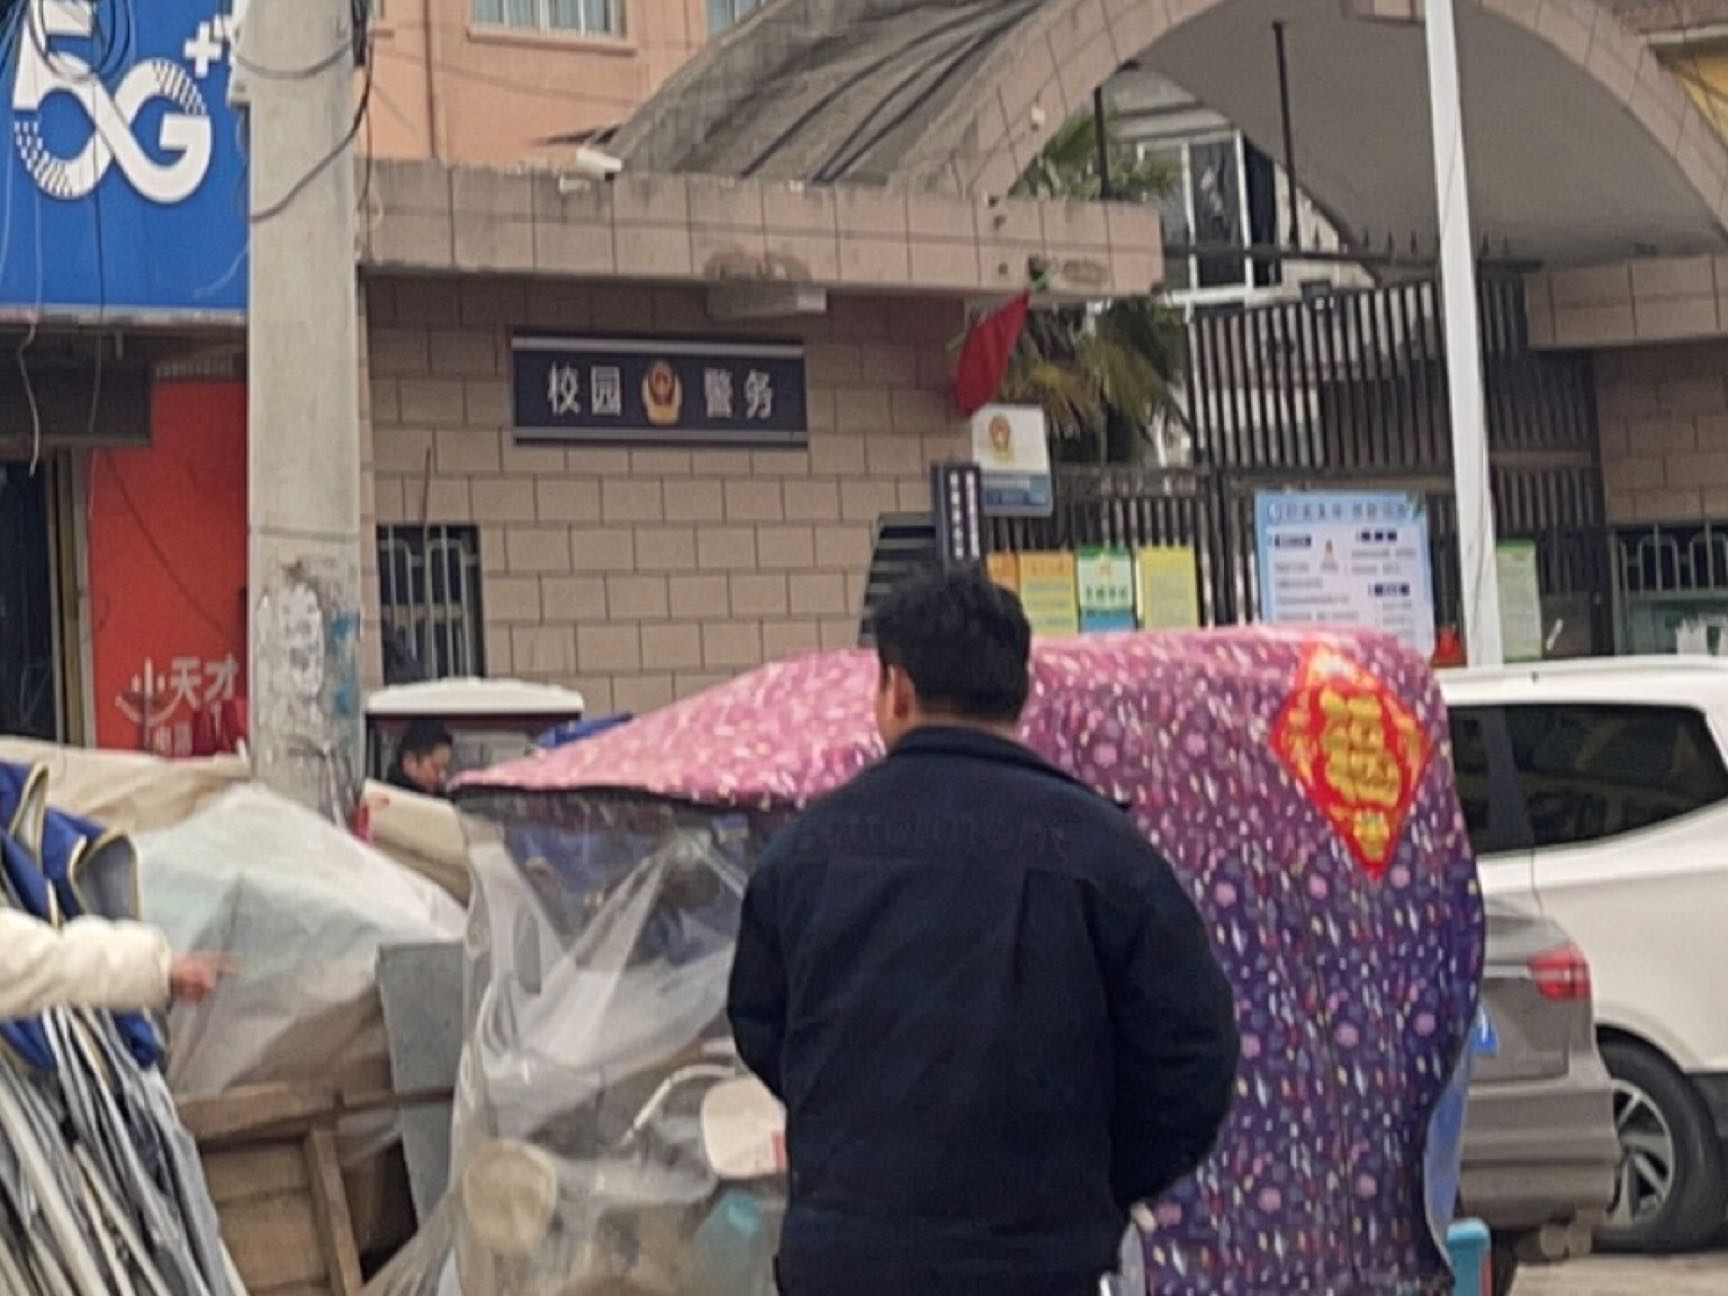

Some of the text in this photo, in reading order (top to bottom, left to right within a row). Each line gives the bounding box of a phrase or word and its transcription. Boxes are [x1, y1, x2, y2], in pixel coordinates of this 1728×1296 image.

[547, 360, 773, 420] 校园 警务
[130, 652, 240, 710] 小天才
[1320, 686, 1403, 808] 福
